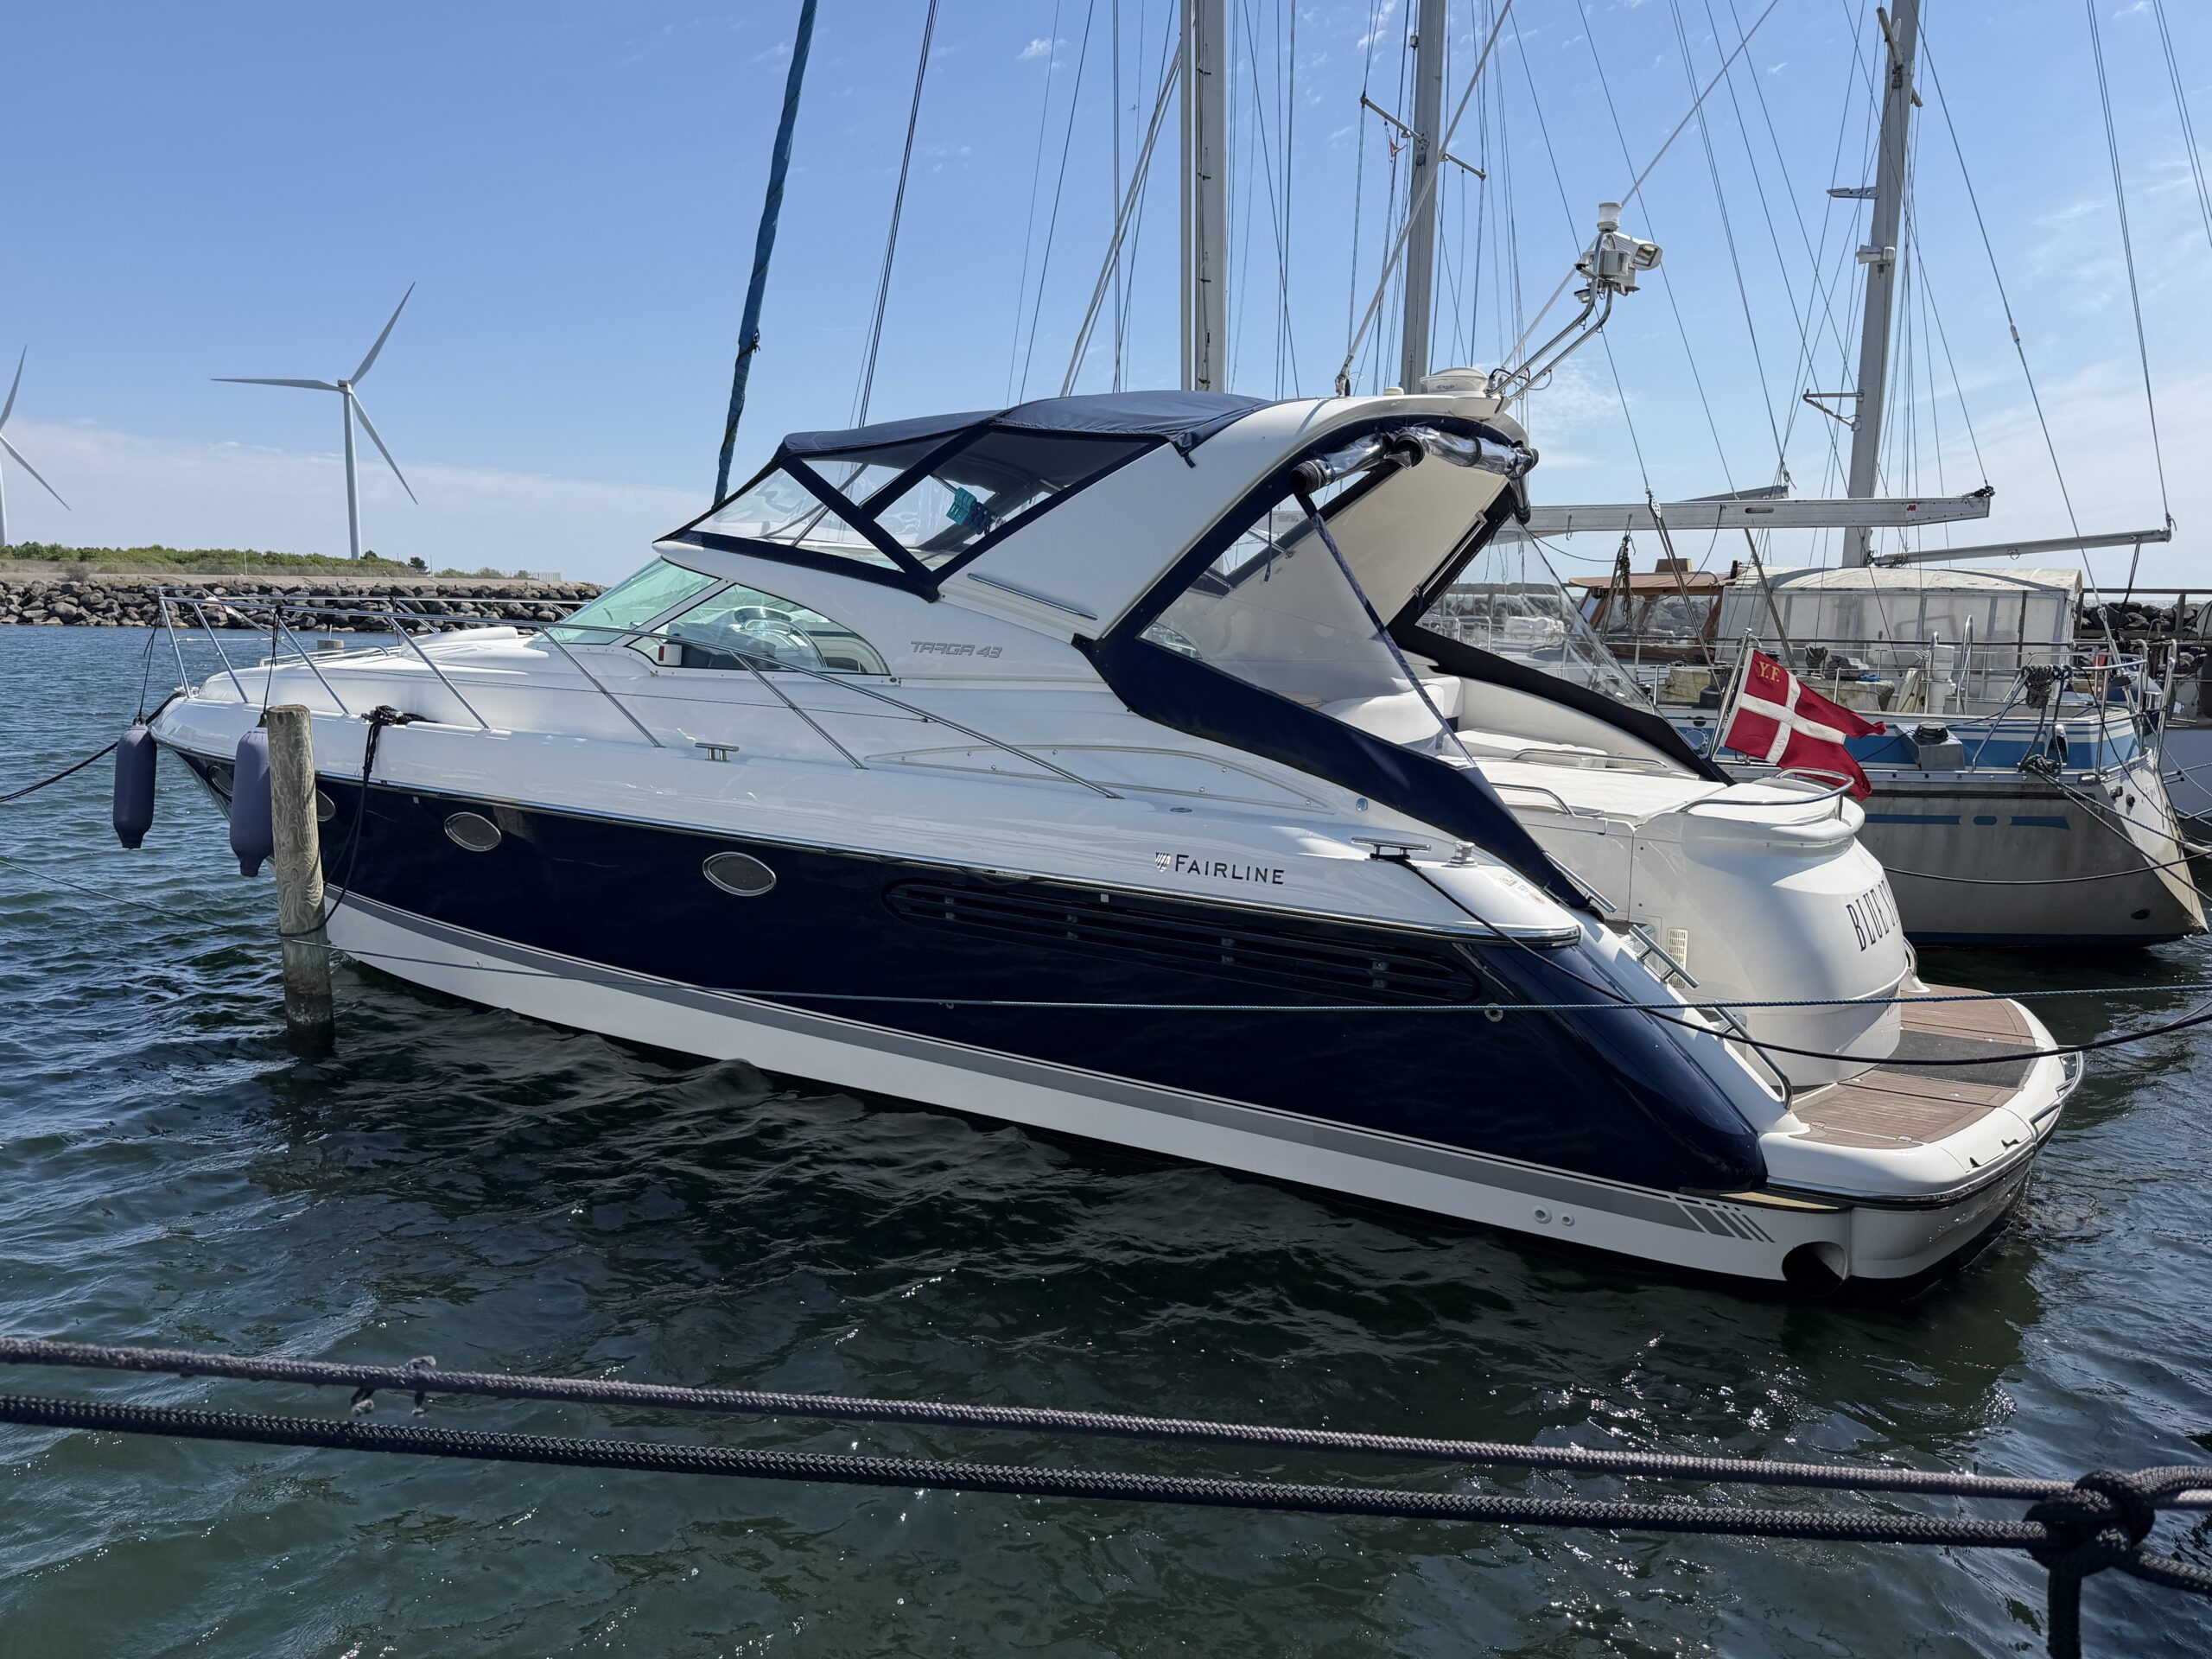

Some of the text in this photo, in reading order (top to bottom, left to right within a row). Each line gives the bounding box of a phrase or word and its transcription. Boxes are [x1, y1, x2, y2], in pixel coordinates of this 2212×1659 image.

[911, 640, 1003, 658] TARGA 43
[1175, 853, 1285, 885] FAIRLINE
[1846, 888, 1890, 952] BLUE
